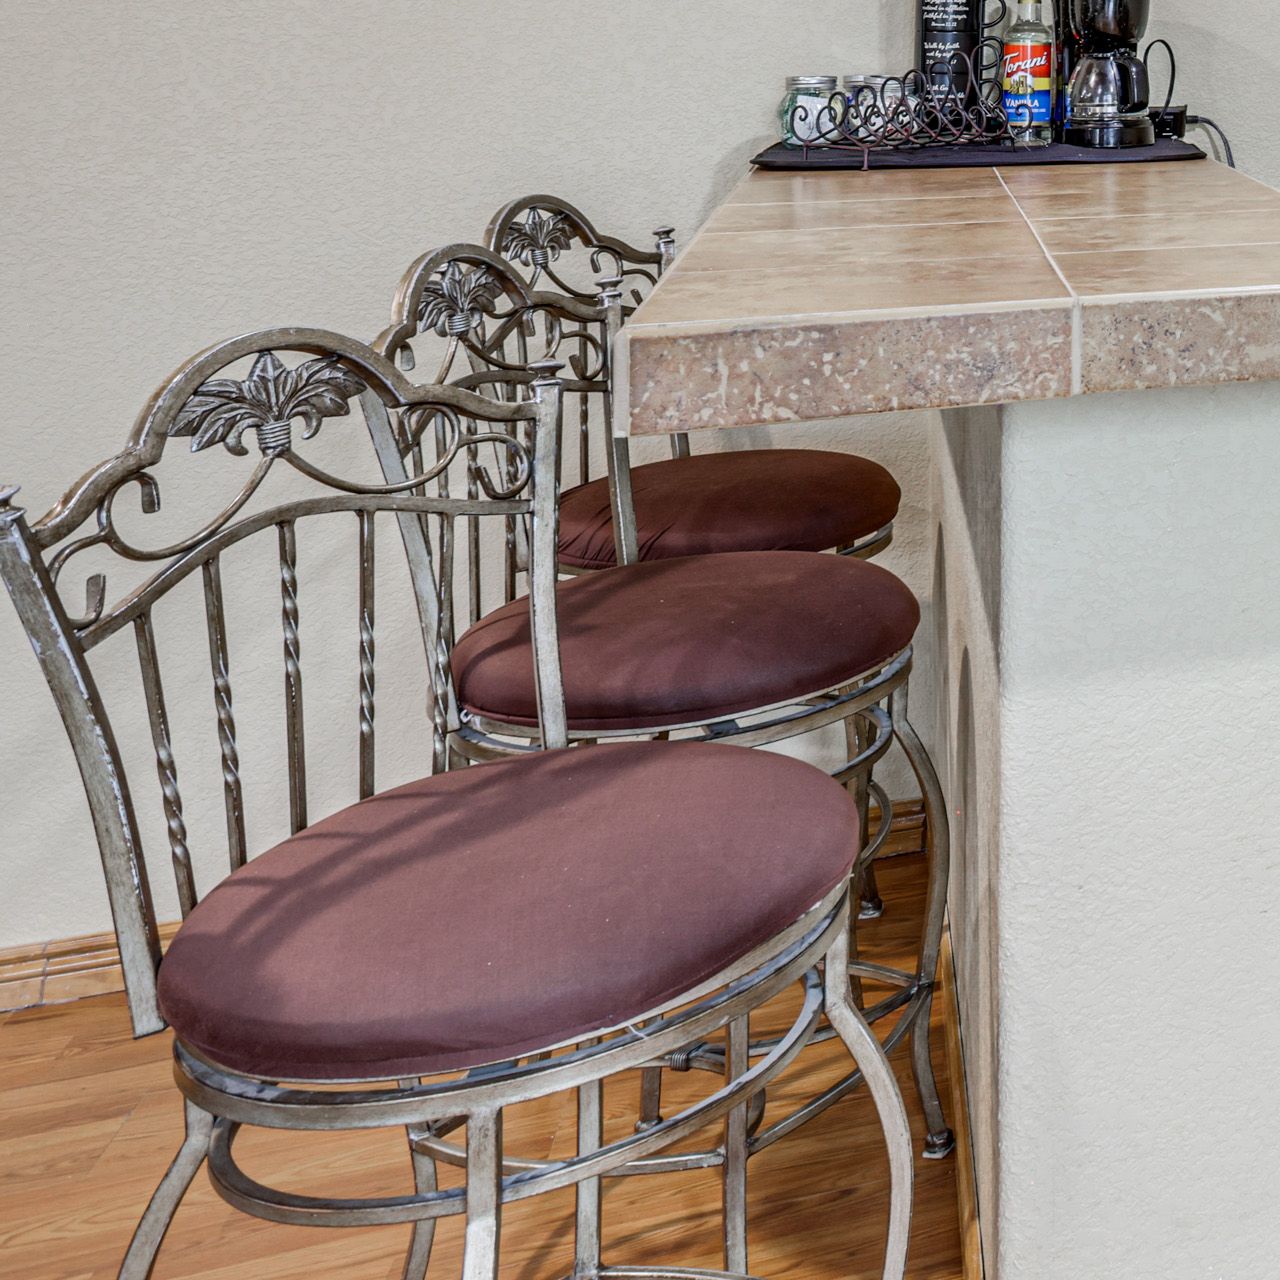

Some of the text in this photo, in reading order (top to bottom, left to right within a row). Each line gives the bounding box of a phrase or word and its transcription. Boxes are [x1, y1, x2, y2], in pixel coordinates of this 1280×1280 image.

[924, 41, 938, 49] Walk
[944, 41, 960, 50] faith
[1004, 51, 1048, 78] Torani
